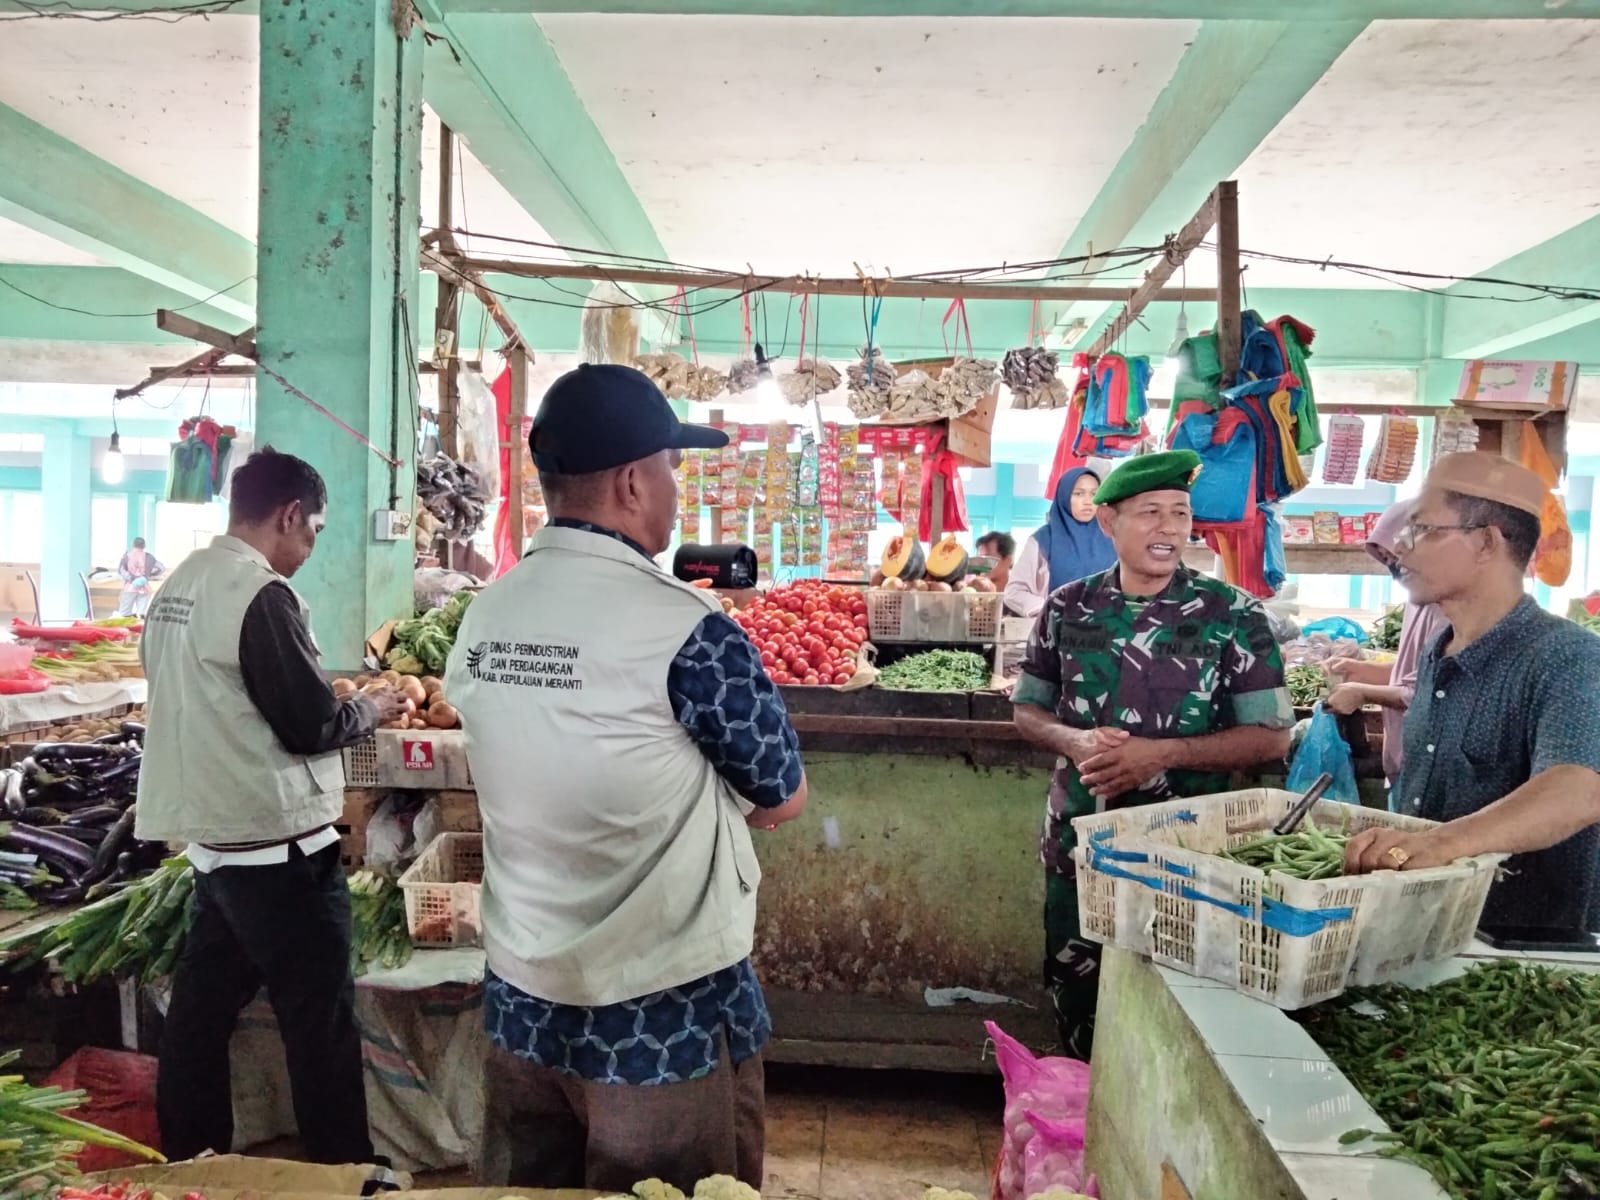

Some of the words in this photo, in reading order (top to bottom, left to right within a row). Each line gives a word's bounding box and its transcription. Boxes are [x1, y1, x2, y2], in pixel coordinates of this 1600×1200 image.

[490, 642, 512, 654] DINAS
[514, 643, 579, 659] PERINDUSTRIAN
[490, 657, 507, 670] DAN
[509, 659, 574, 676] PERDAGANGAN
[500, 674, 542, 687] KEPULAUAN
[545, 679, 582, 690] MERANTI
